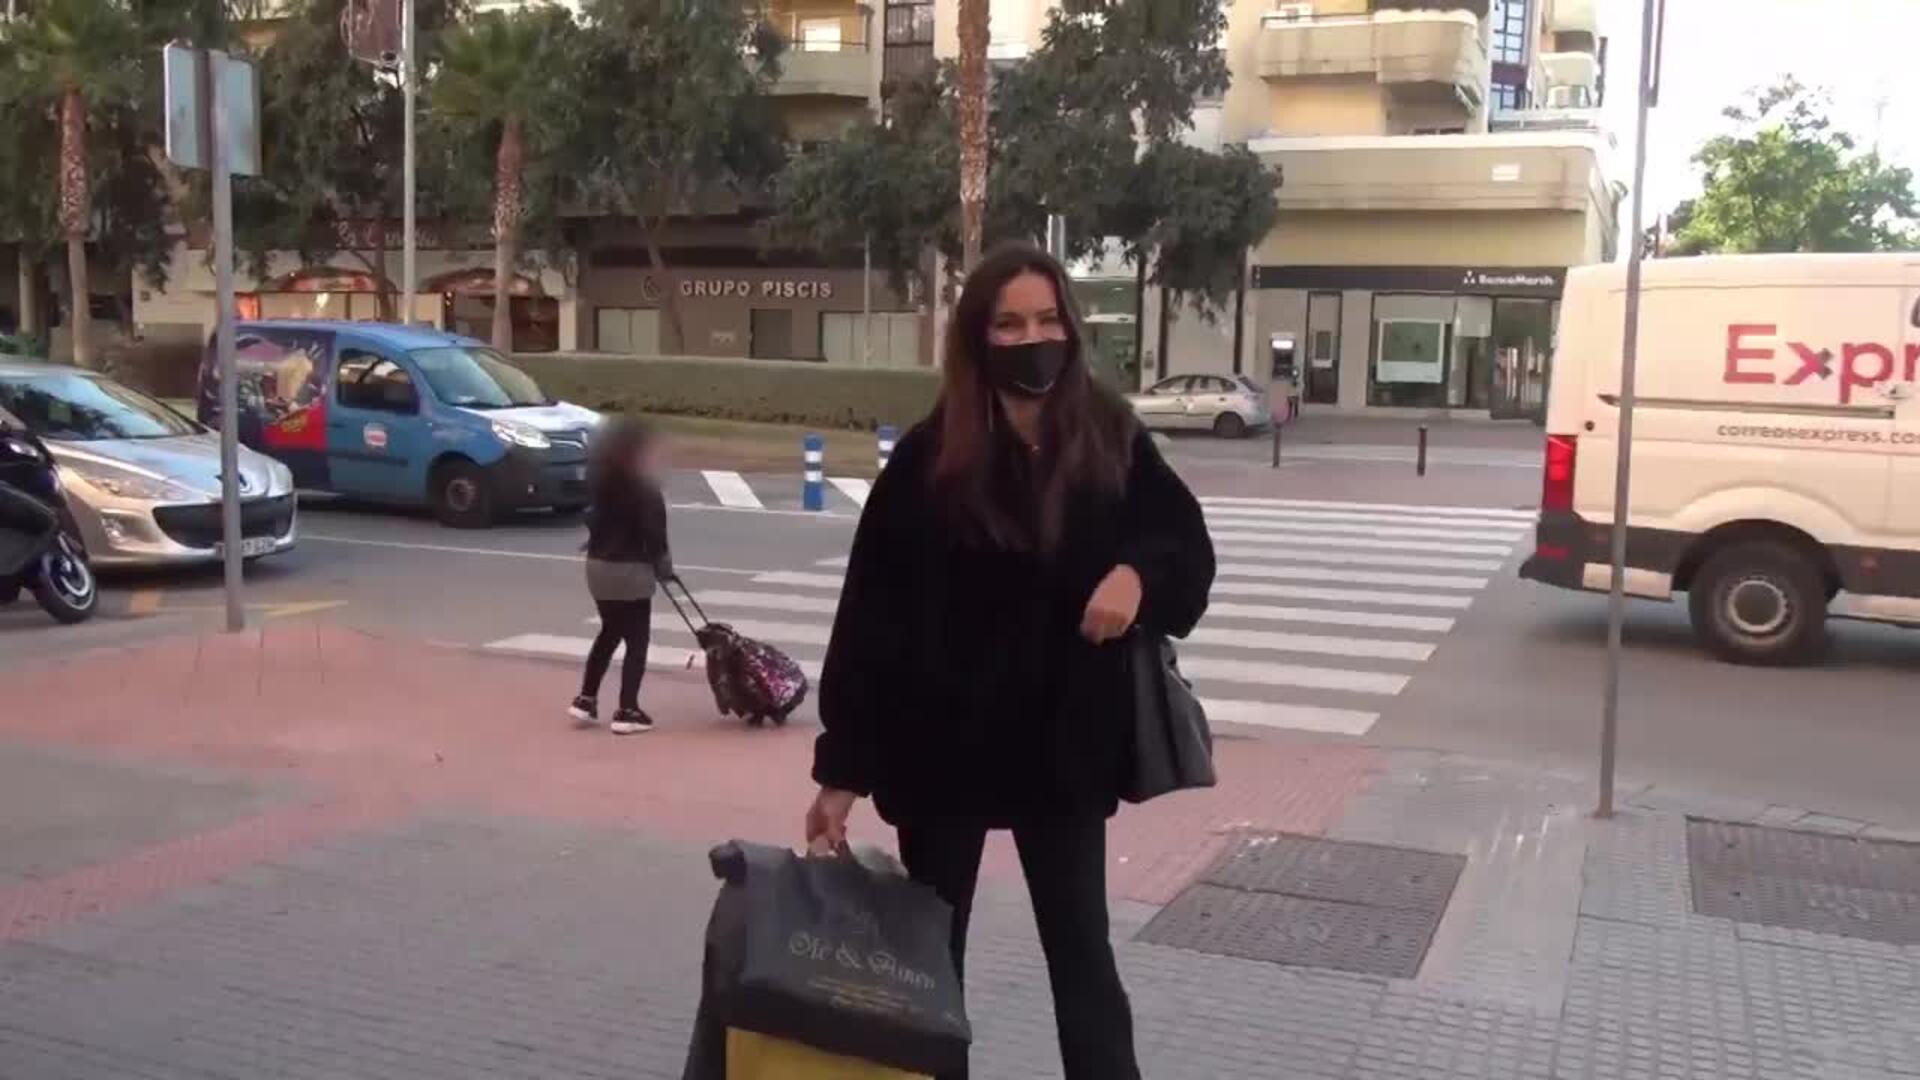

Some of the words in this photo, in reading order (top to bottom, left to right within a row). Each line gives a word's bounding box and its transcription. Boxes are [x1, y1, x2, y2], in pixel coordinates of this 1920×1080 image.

[681, 279, 751, 297] GRUPO
[762, 280, 833, 299] PISCIS
[1716, 424, 1920, 445] correosexpress.co
